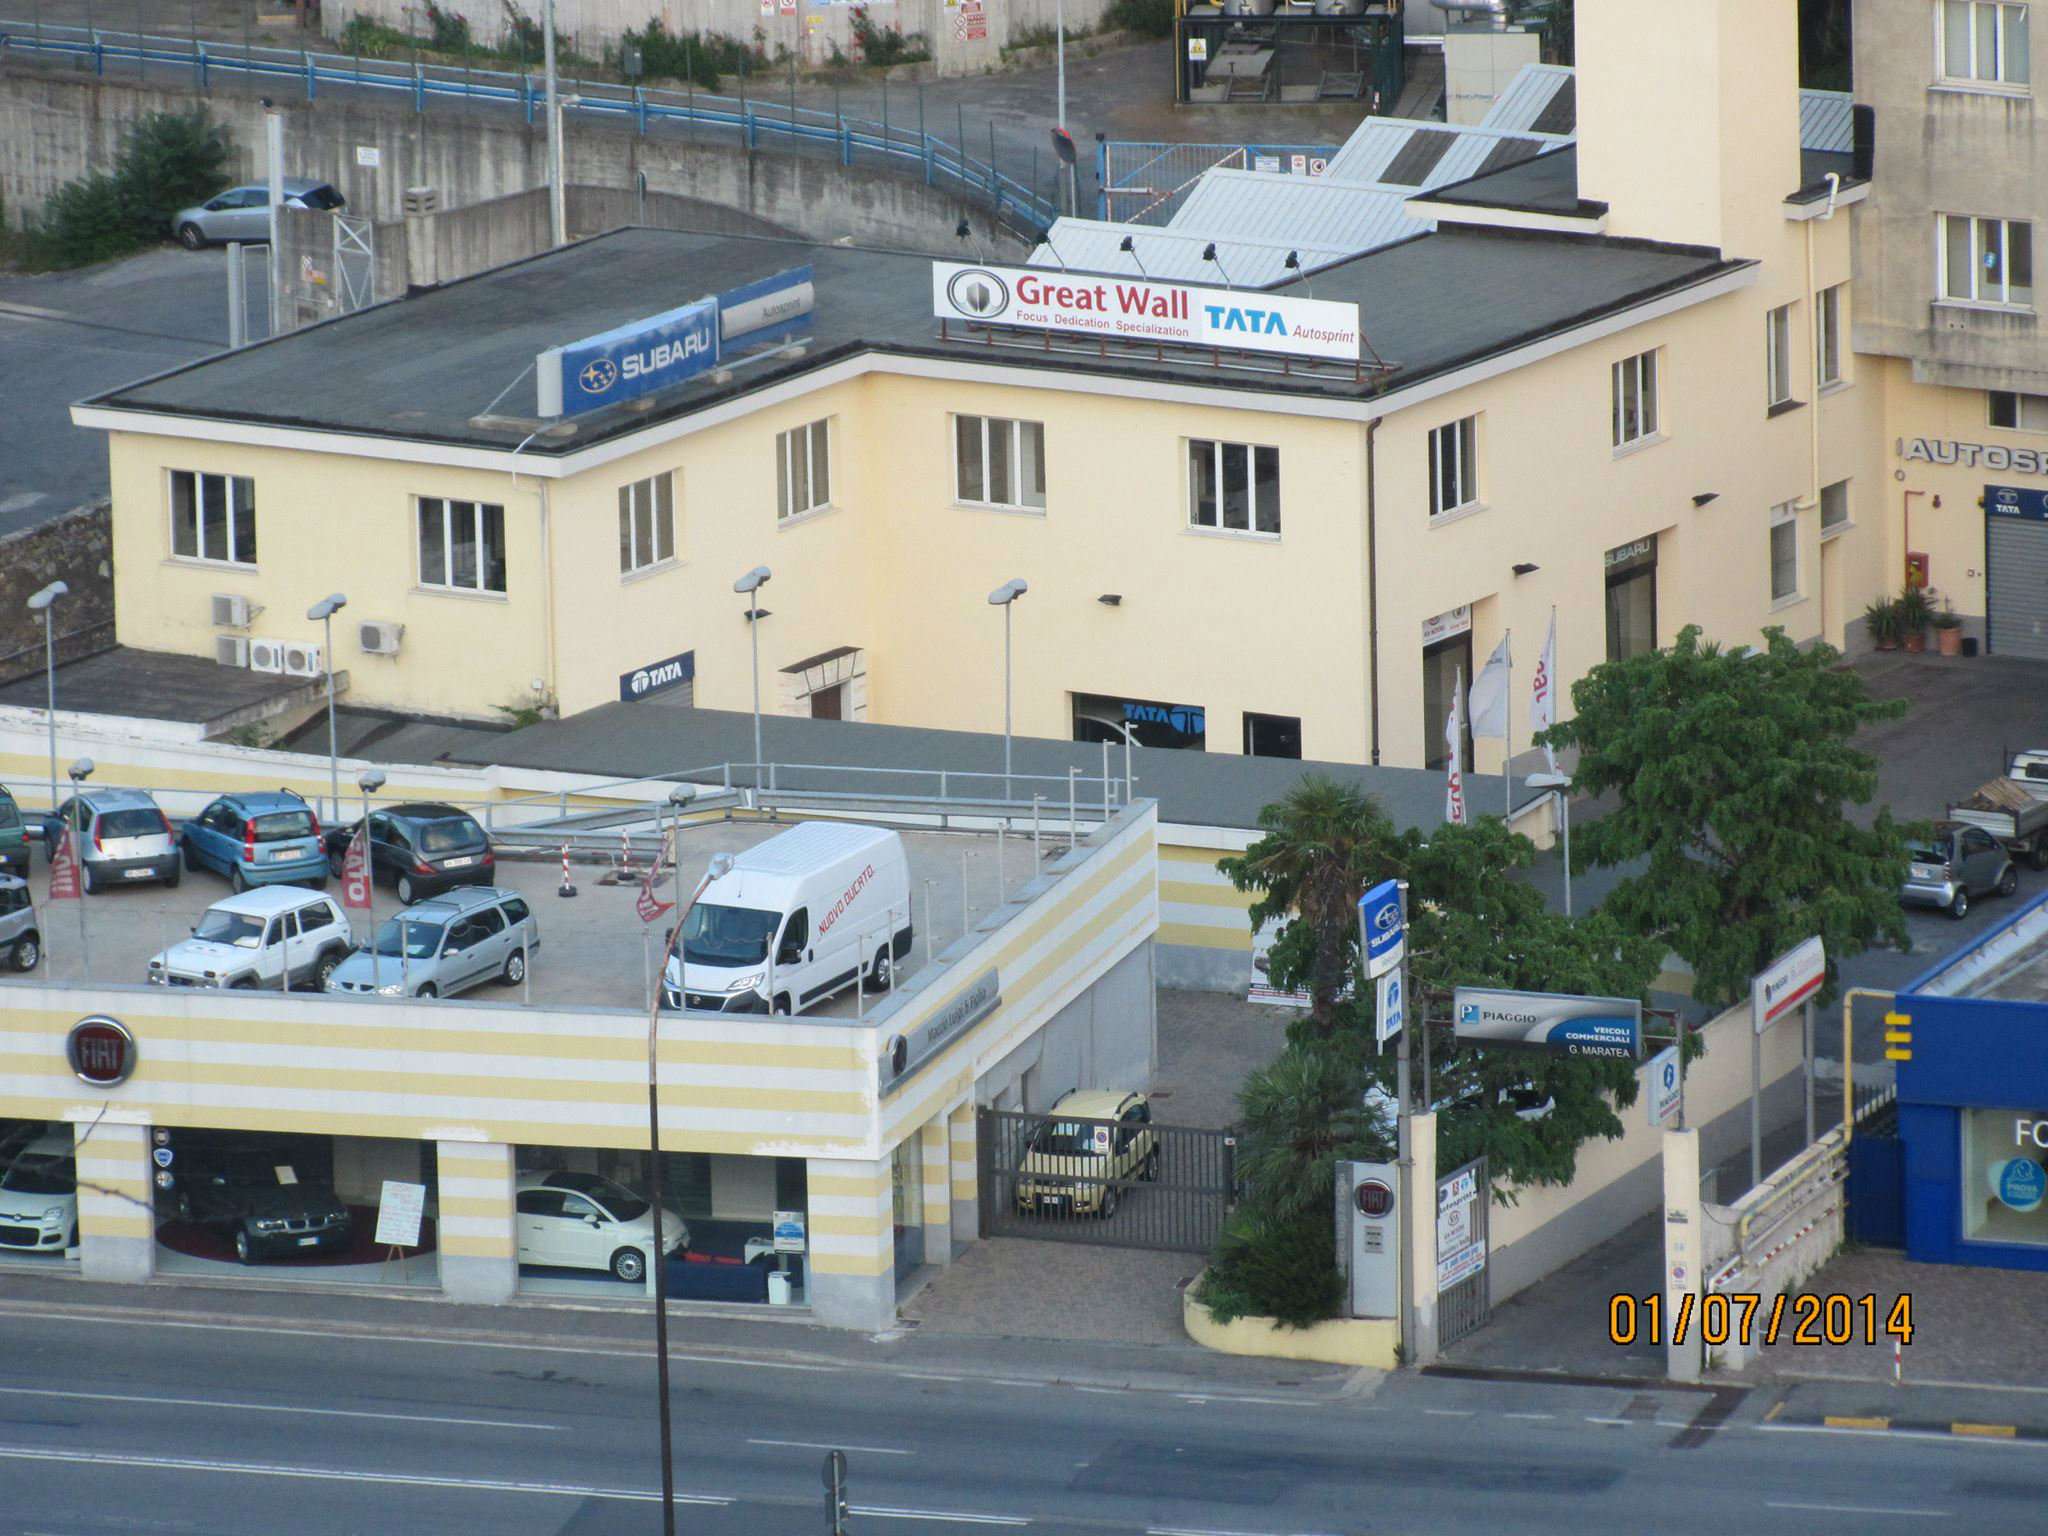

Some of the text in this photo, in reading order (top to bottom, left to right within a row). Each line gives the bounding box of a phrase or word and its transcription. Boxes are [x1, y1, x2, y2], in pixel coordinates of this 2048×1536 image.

[1016, 276, 1189, 320] Great Wall
[1016, 310, 1190, 337] Focus Dedication Specialization
[1204, 305, 1288, 336] TATA
[1293, 325, 1355, 344] Autosprint
[622, 327, 710, 380] SUBARU
[1905, 438, 2048, 476] AUTOS
[1996, 504, 2020, 514] TATA
[1605, 539, 1650, 567] SUBARU
[649, 661, 683, 686] TATA
[1122, 703, 1170, 723] TATA
[818, 864, 875, 937] NUOVO DUCATO
[1482, 1010, 1538, 1025] PIAGGIO
[1565, 1031, 1631, 1044] COMMERCIALI
[1593, 1025, 1631, 1036] VEICOLI
[1569, 1044, 1631, 1058] G. MARATEA
